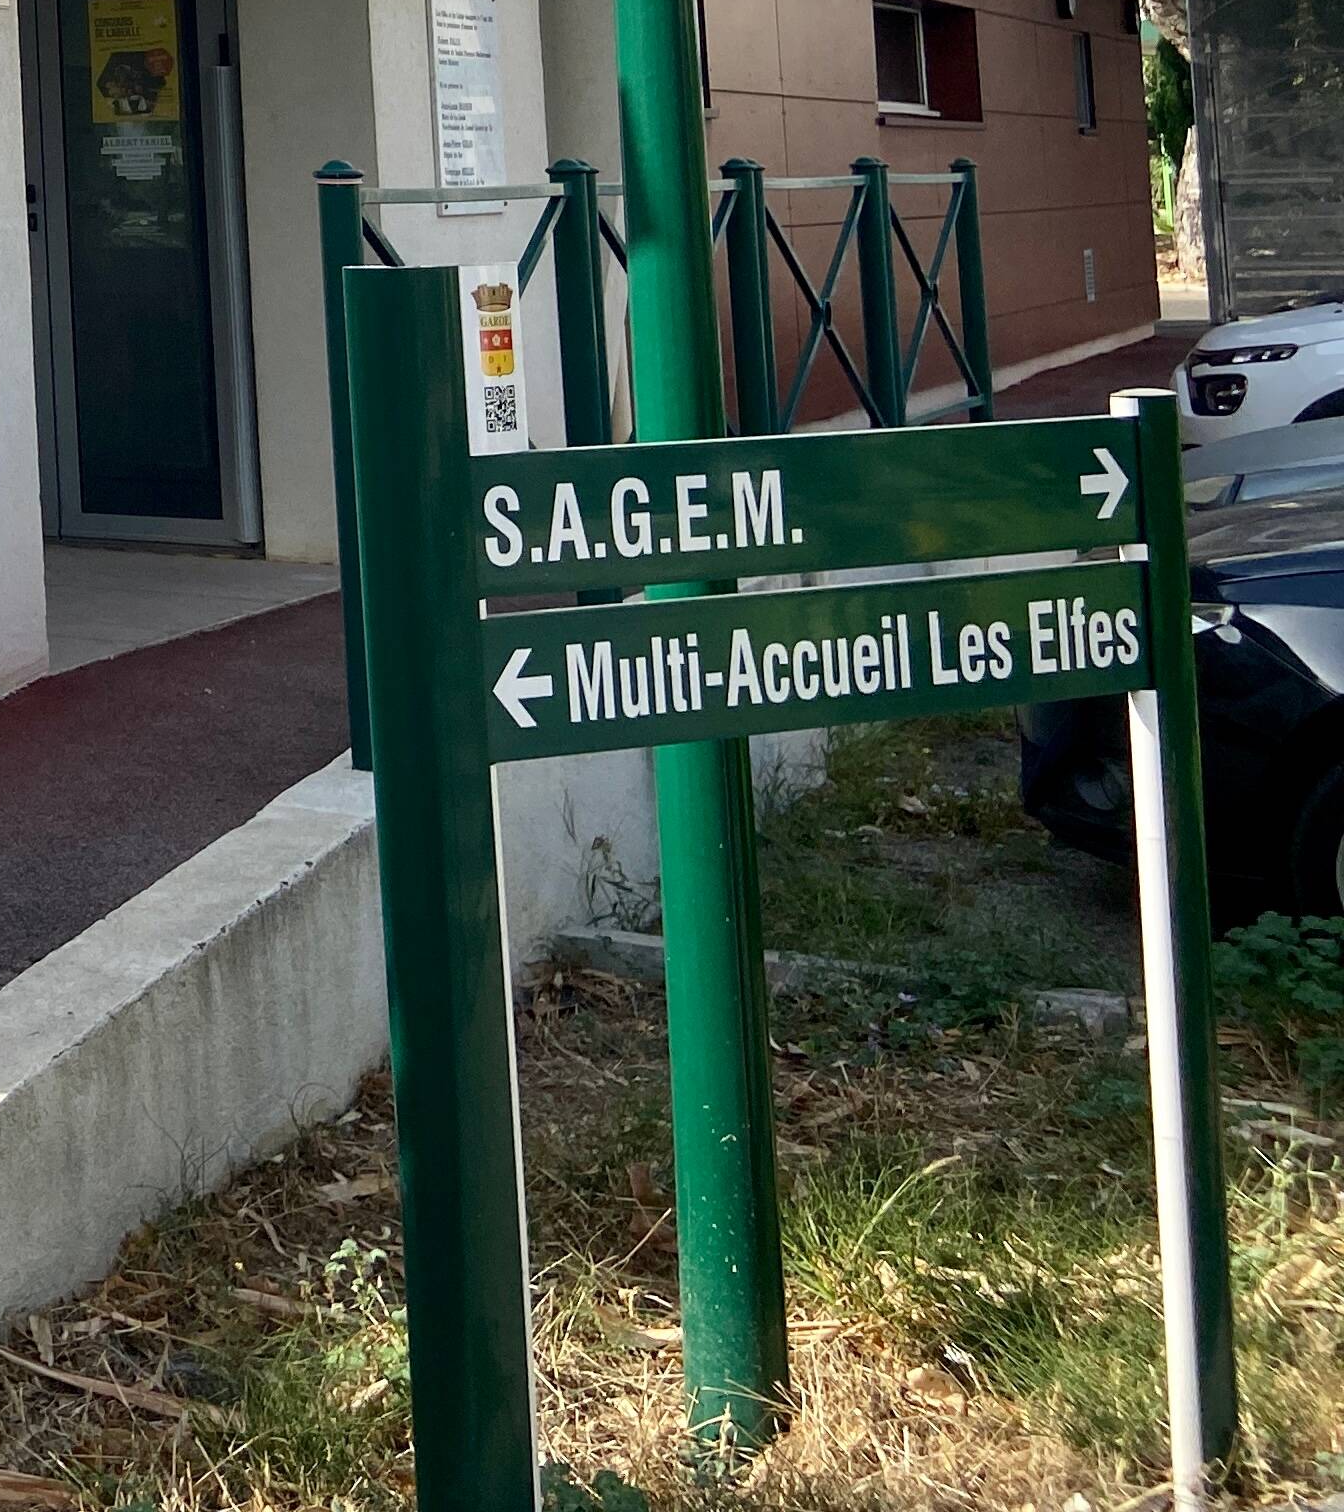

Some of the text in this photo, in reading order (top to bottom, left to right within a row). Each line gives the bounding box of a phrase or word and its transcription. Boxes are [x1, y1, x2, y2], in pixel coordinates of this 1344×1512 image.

[483, 469, 805, 567] S.A.G.E.M.
[566, 597, 1140, 723] Multi-Accueil Les Elfes
